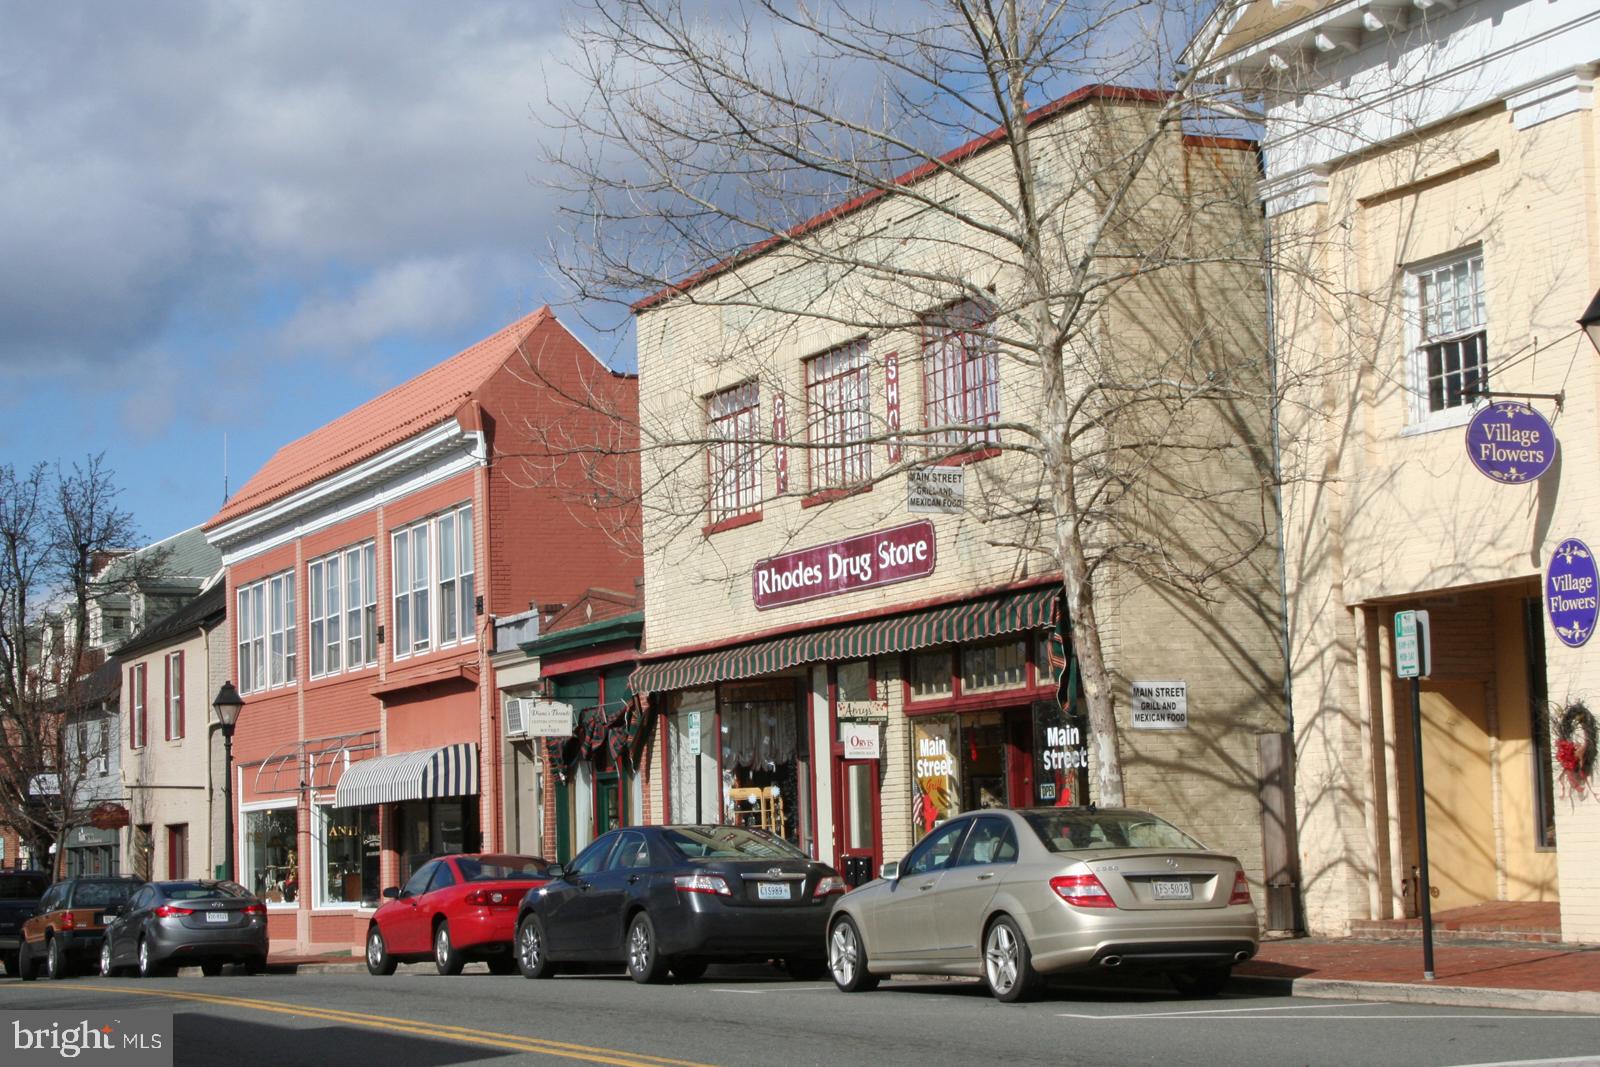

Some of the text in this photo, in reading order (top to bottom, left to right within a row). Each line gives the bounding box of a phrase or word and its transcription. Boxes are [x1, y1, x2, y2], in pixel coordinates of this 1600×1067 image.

[1482, 423, 1539, 447] Village
[1480, 443, 1544, 463] Flowers
[932, 473, 962, 483] STREET
[911, 498, 962, 507] MEXICAN FOOD
[758, 540, 928, 595] Rhodes Drug Store
[1552, 573, 1592, 593] Village
[1550, 595, 1596, 613] Flowers
[1133, 687, 1185, 697] MAIN STREET
[1140, 702, 1177, 711] GRILL AND
[1134, 713, 1186, 722] MEXICAN FOOD
[1046, 724, 1080, 747] Main
[919, 736, 946, 757] Main
[916, 757, 953, 778] Street
[1043, 746, 1087, 770] Street
